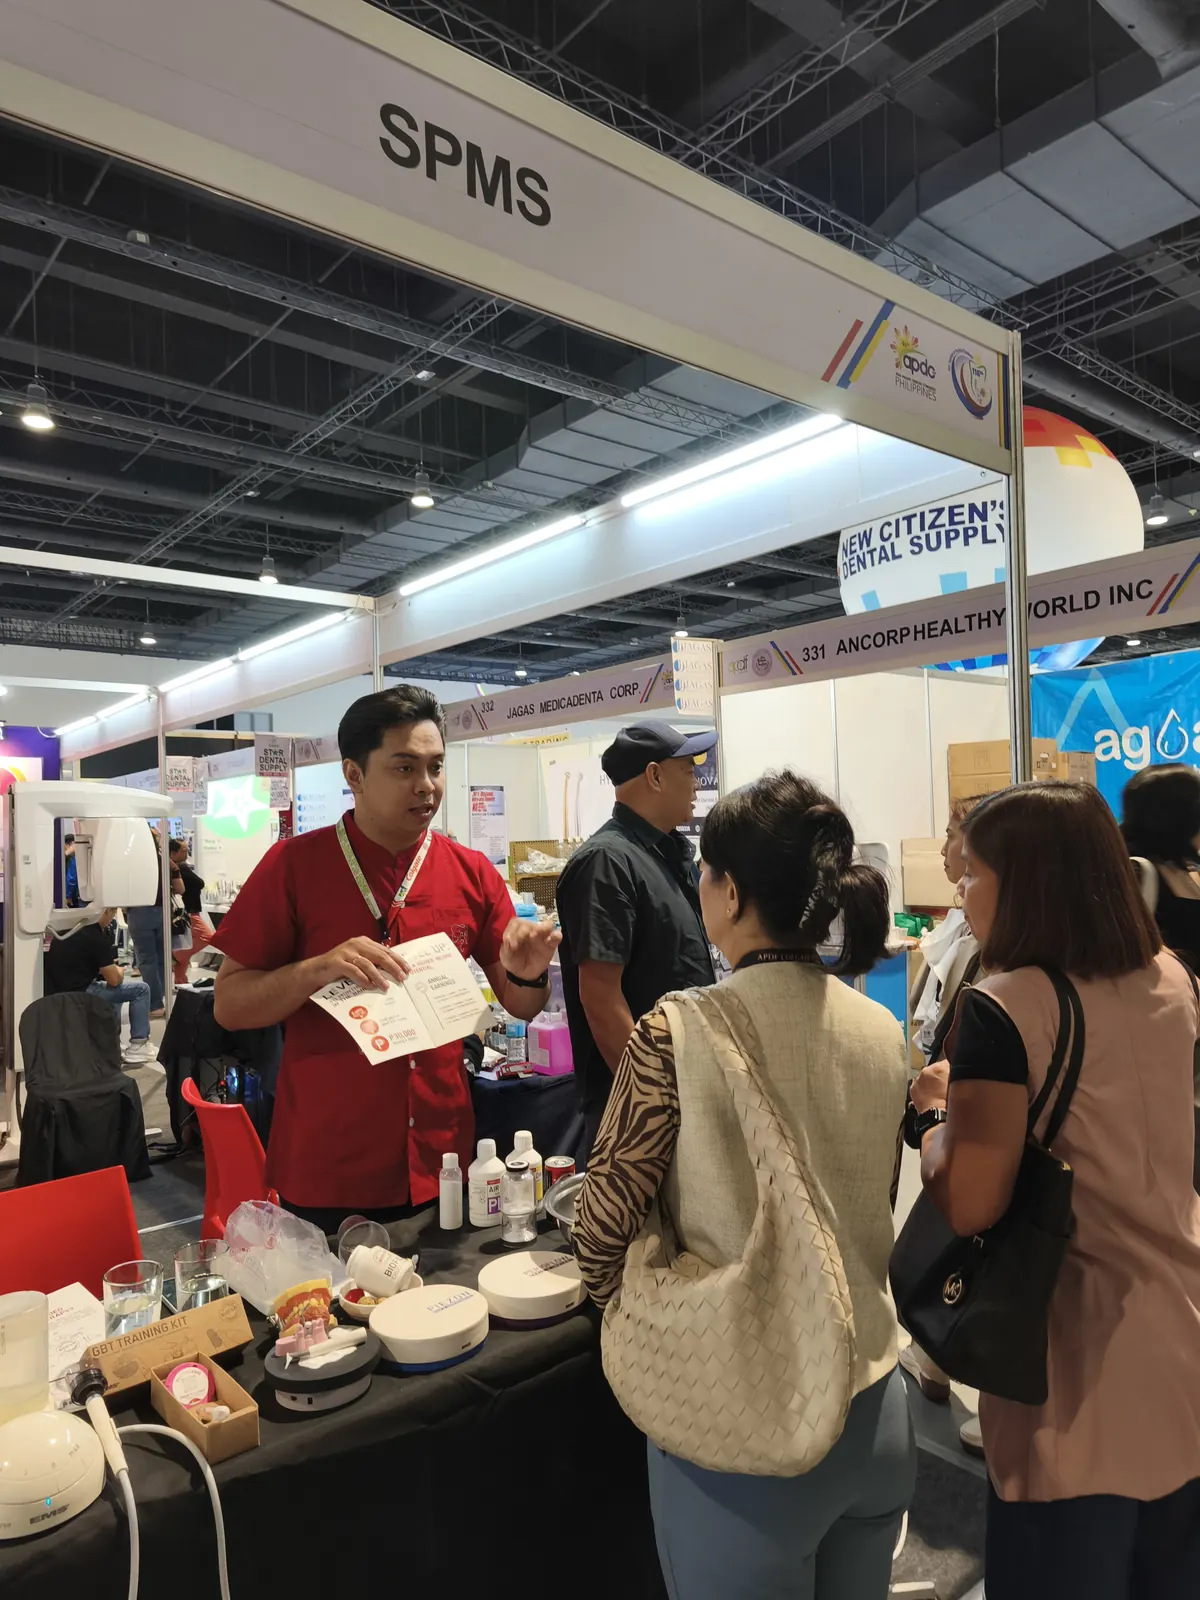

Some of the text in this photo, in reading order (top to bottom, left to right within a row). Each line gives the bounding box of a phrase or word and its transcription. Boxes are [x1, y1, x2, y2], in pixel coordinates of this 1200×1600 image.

[379, 103, 552, 227] SPMS
[895, 377, 937, 402] PHILIPPINES
[842, 527, 873, 561] NEW
[842, 542, 902, 580] DENTAL
[802, 644, 825, 662] 331
[1028, 590, 1101, 620] ORLD
[1109, 579, 1153, 605] INC
[481, 682, 641, 719] 332 JAGAS MEDICADENTA CORP.
[259, 756, 288, 765] DENTAL
[259, 764, 288, 772] SUPPLY
[92, 1316, 188, 1357] GBT TRAINING KIT
[29, 1504, 70, 1525] EMS
